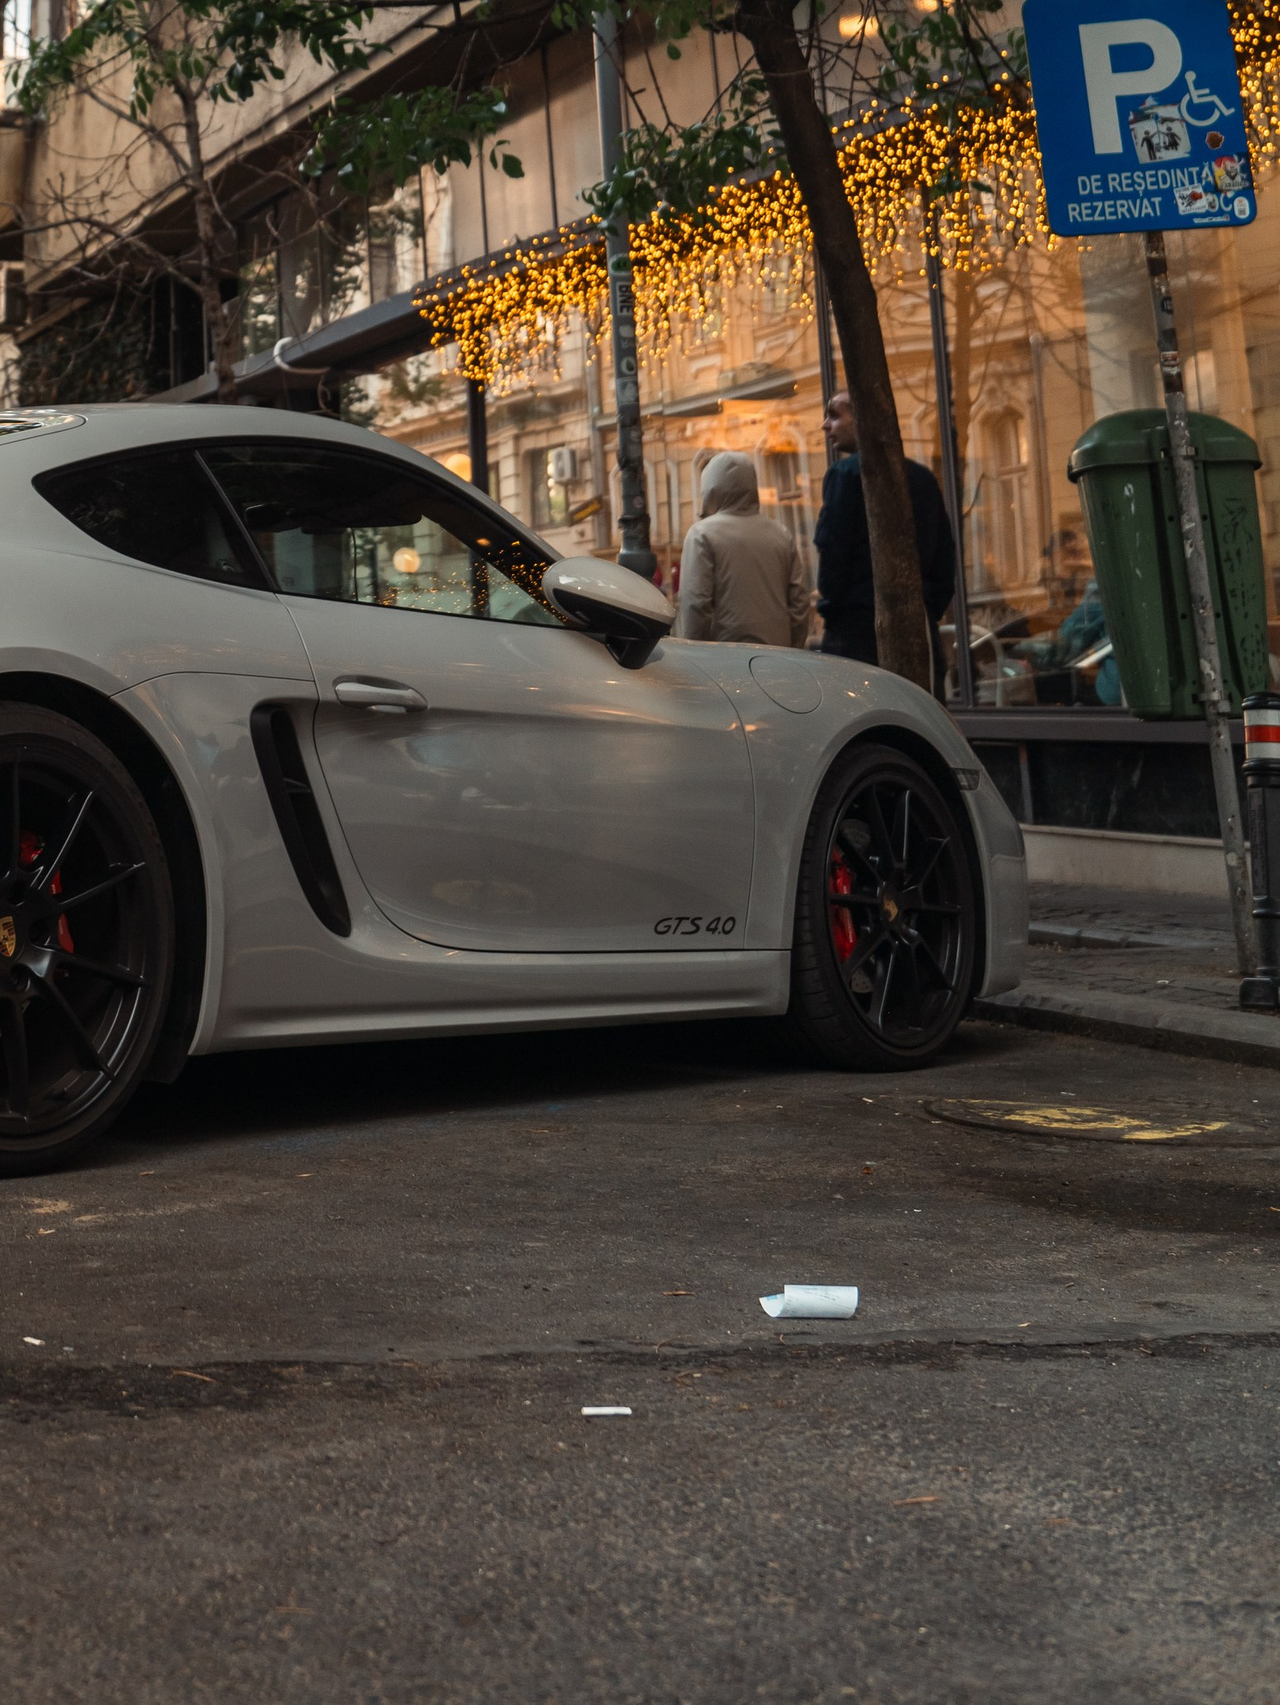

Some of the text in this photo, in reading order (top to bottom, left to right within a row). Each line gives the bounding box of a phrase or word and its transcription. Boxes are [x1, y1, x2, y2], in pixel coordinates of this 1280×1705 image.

[1079, 18, 1182, 155] P
[1077, 175, 1103, 195] DE
[1068, 197, 1162, 223] REZERVAT
[654, 916, 737, 935] GTS 4.0
